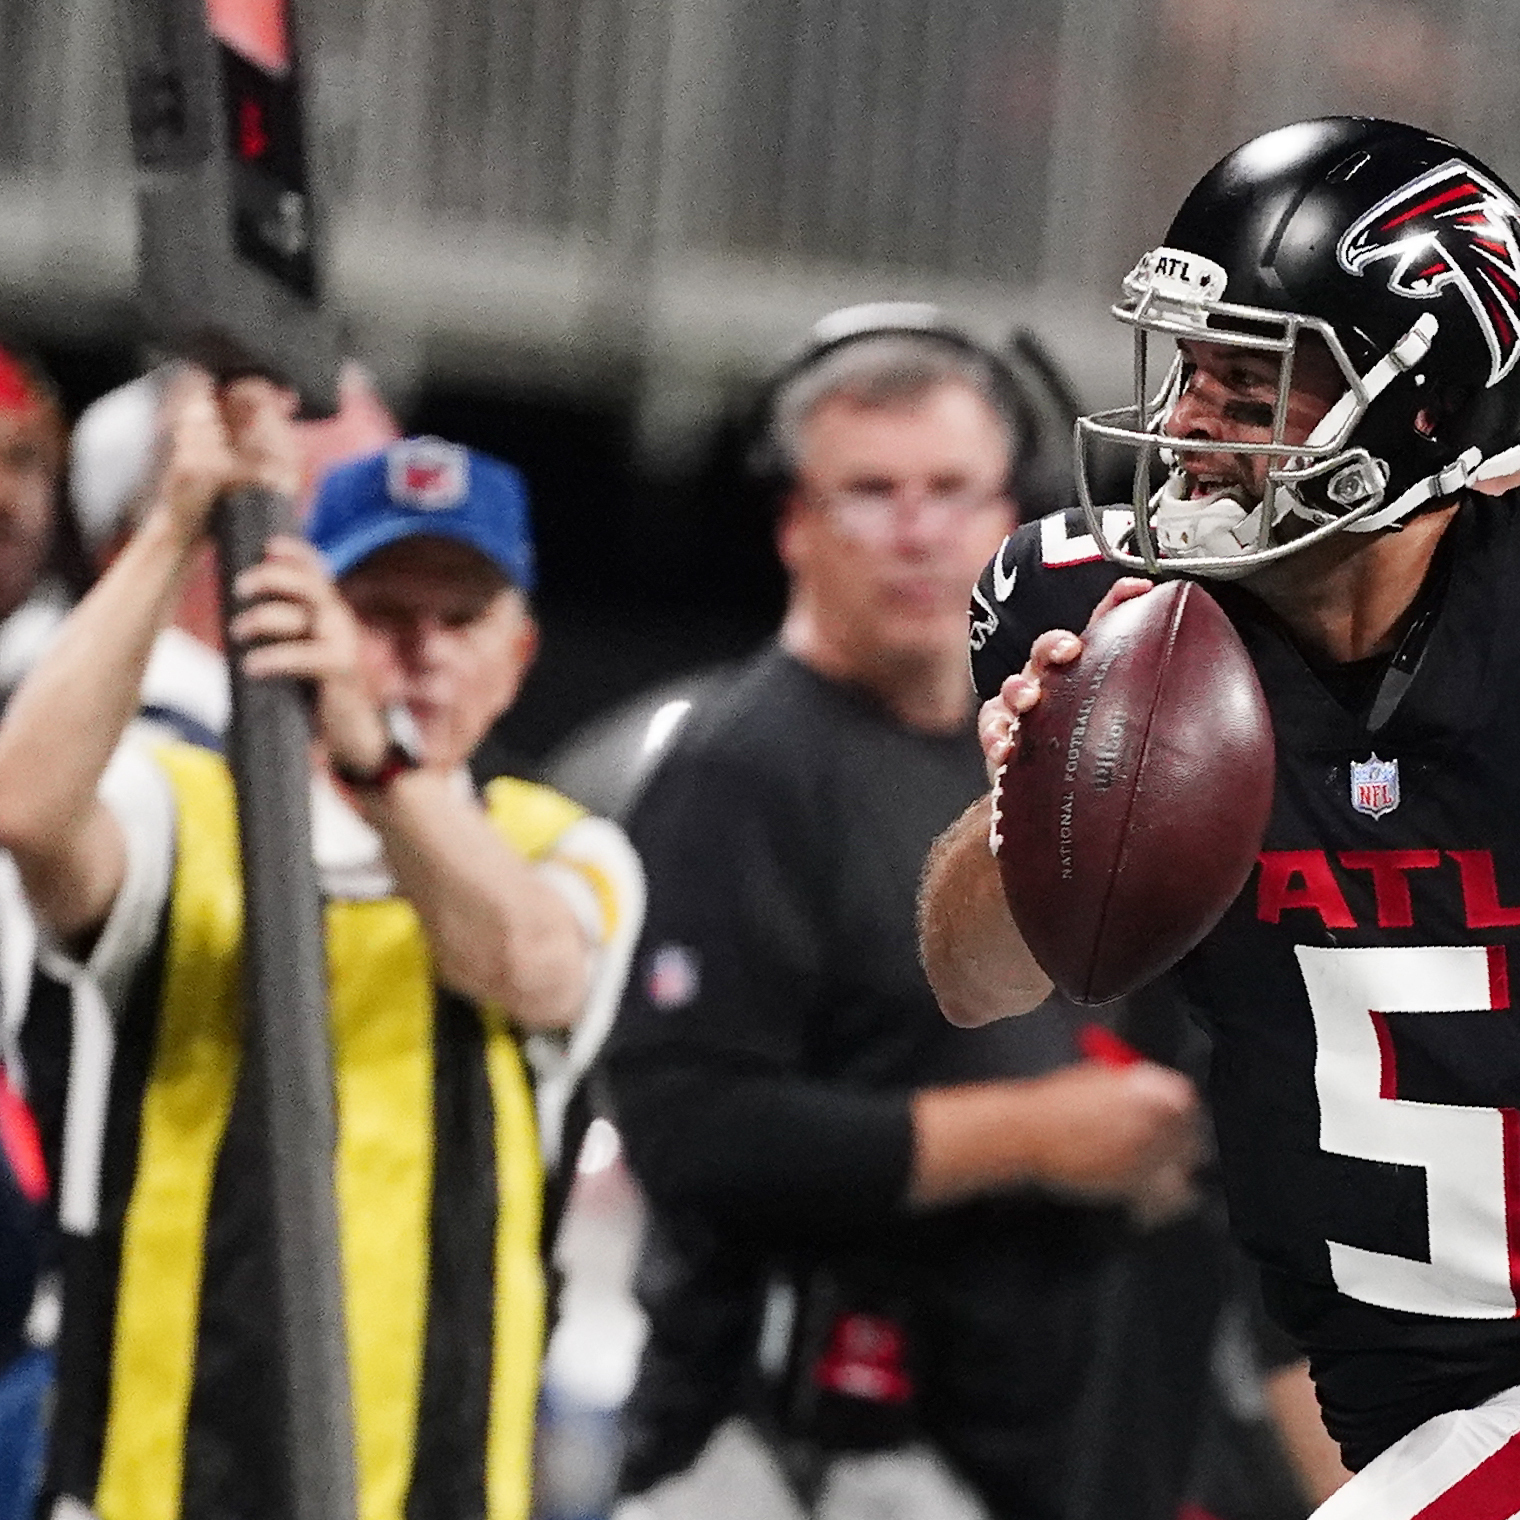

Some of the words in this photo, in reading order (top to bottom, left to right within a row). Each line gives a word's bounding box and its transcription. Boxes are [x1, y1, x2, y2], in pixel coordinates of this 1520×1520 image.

[1154, 256, 1190, 282] ATL
[1063, 696, 1097, 783] FOOTBALL
[1358, 784, 1393, 808] NFL
[1060, 791, 1076, 880] NATIONAL
